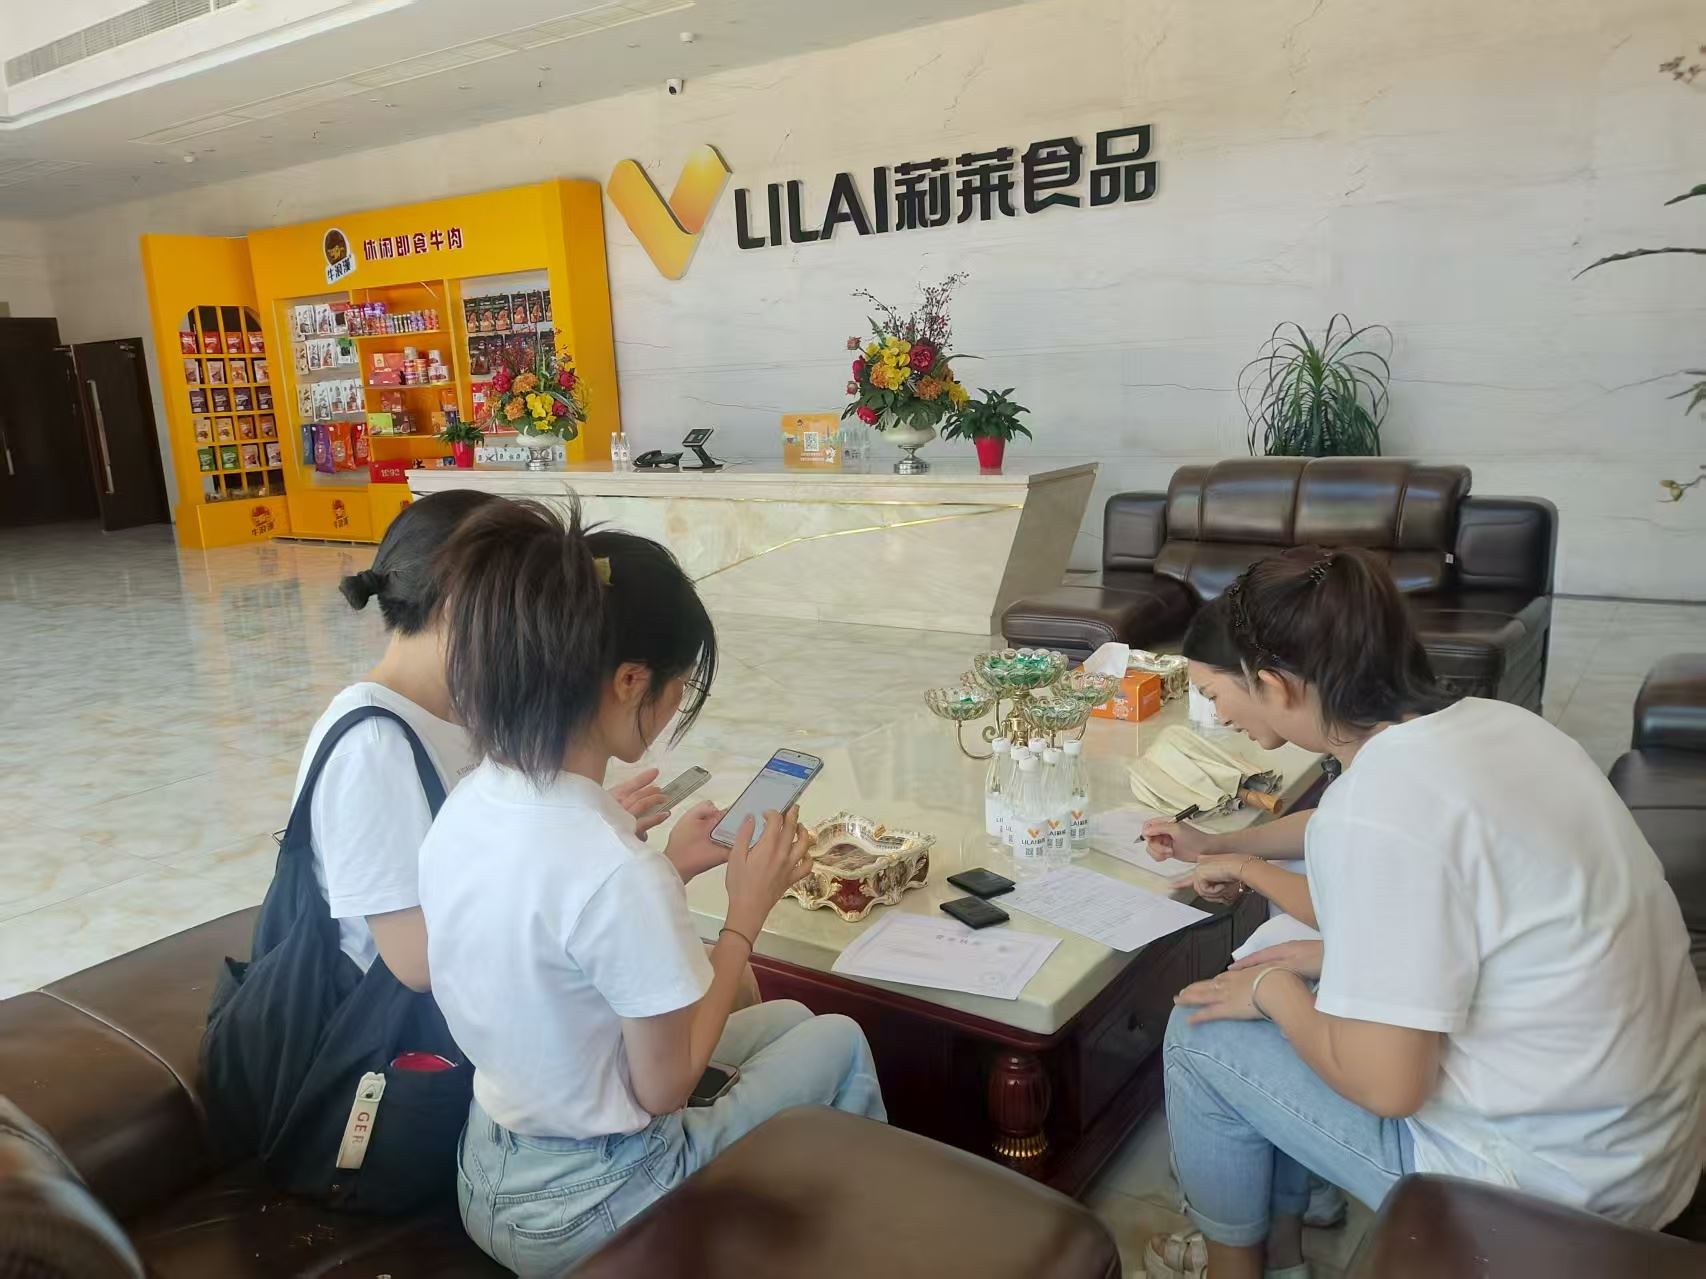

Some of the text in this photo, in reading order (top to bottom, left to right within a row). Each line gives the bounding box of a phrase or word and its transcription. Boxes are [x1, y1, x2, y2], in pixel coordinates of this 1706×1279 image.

[734, 123, 1159, 250] LILAI 莉莱食品
[363, 226, 463, 261] 休闲即食牛肉
